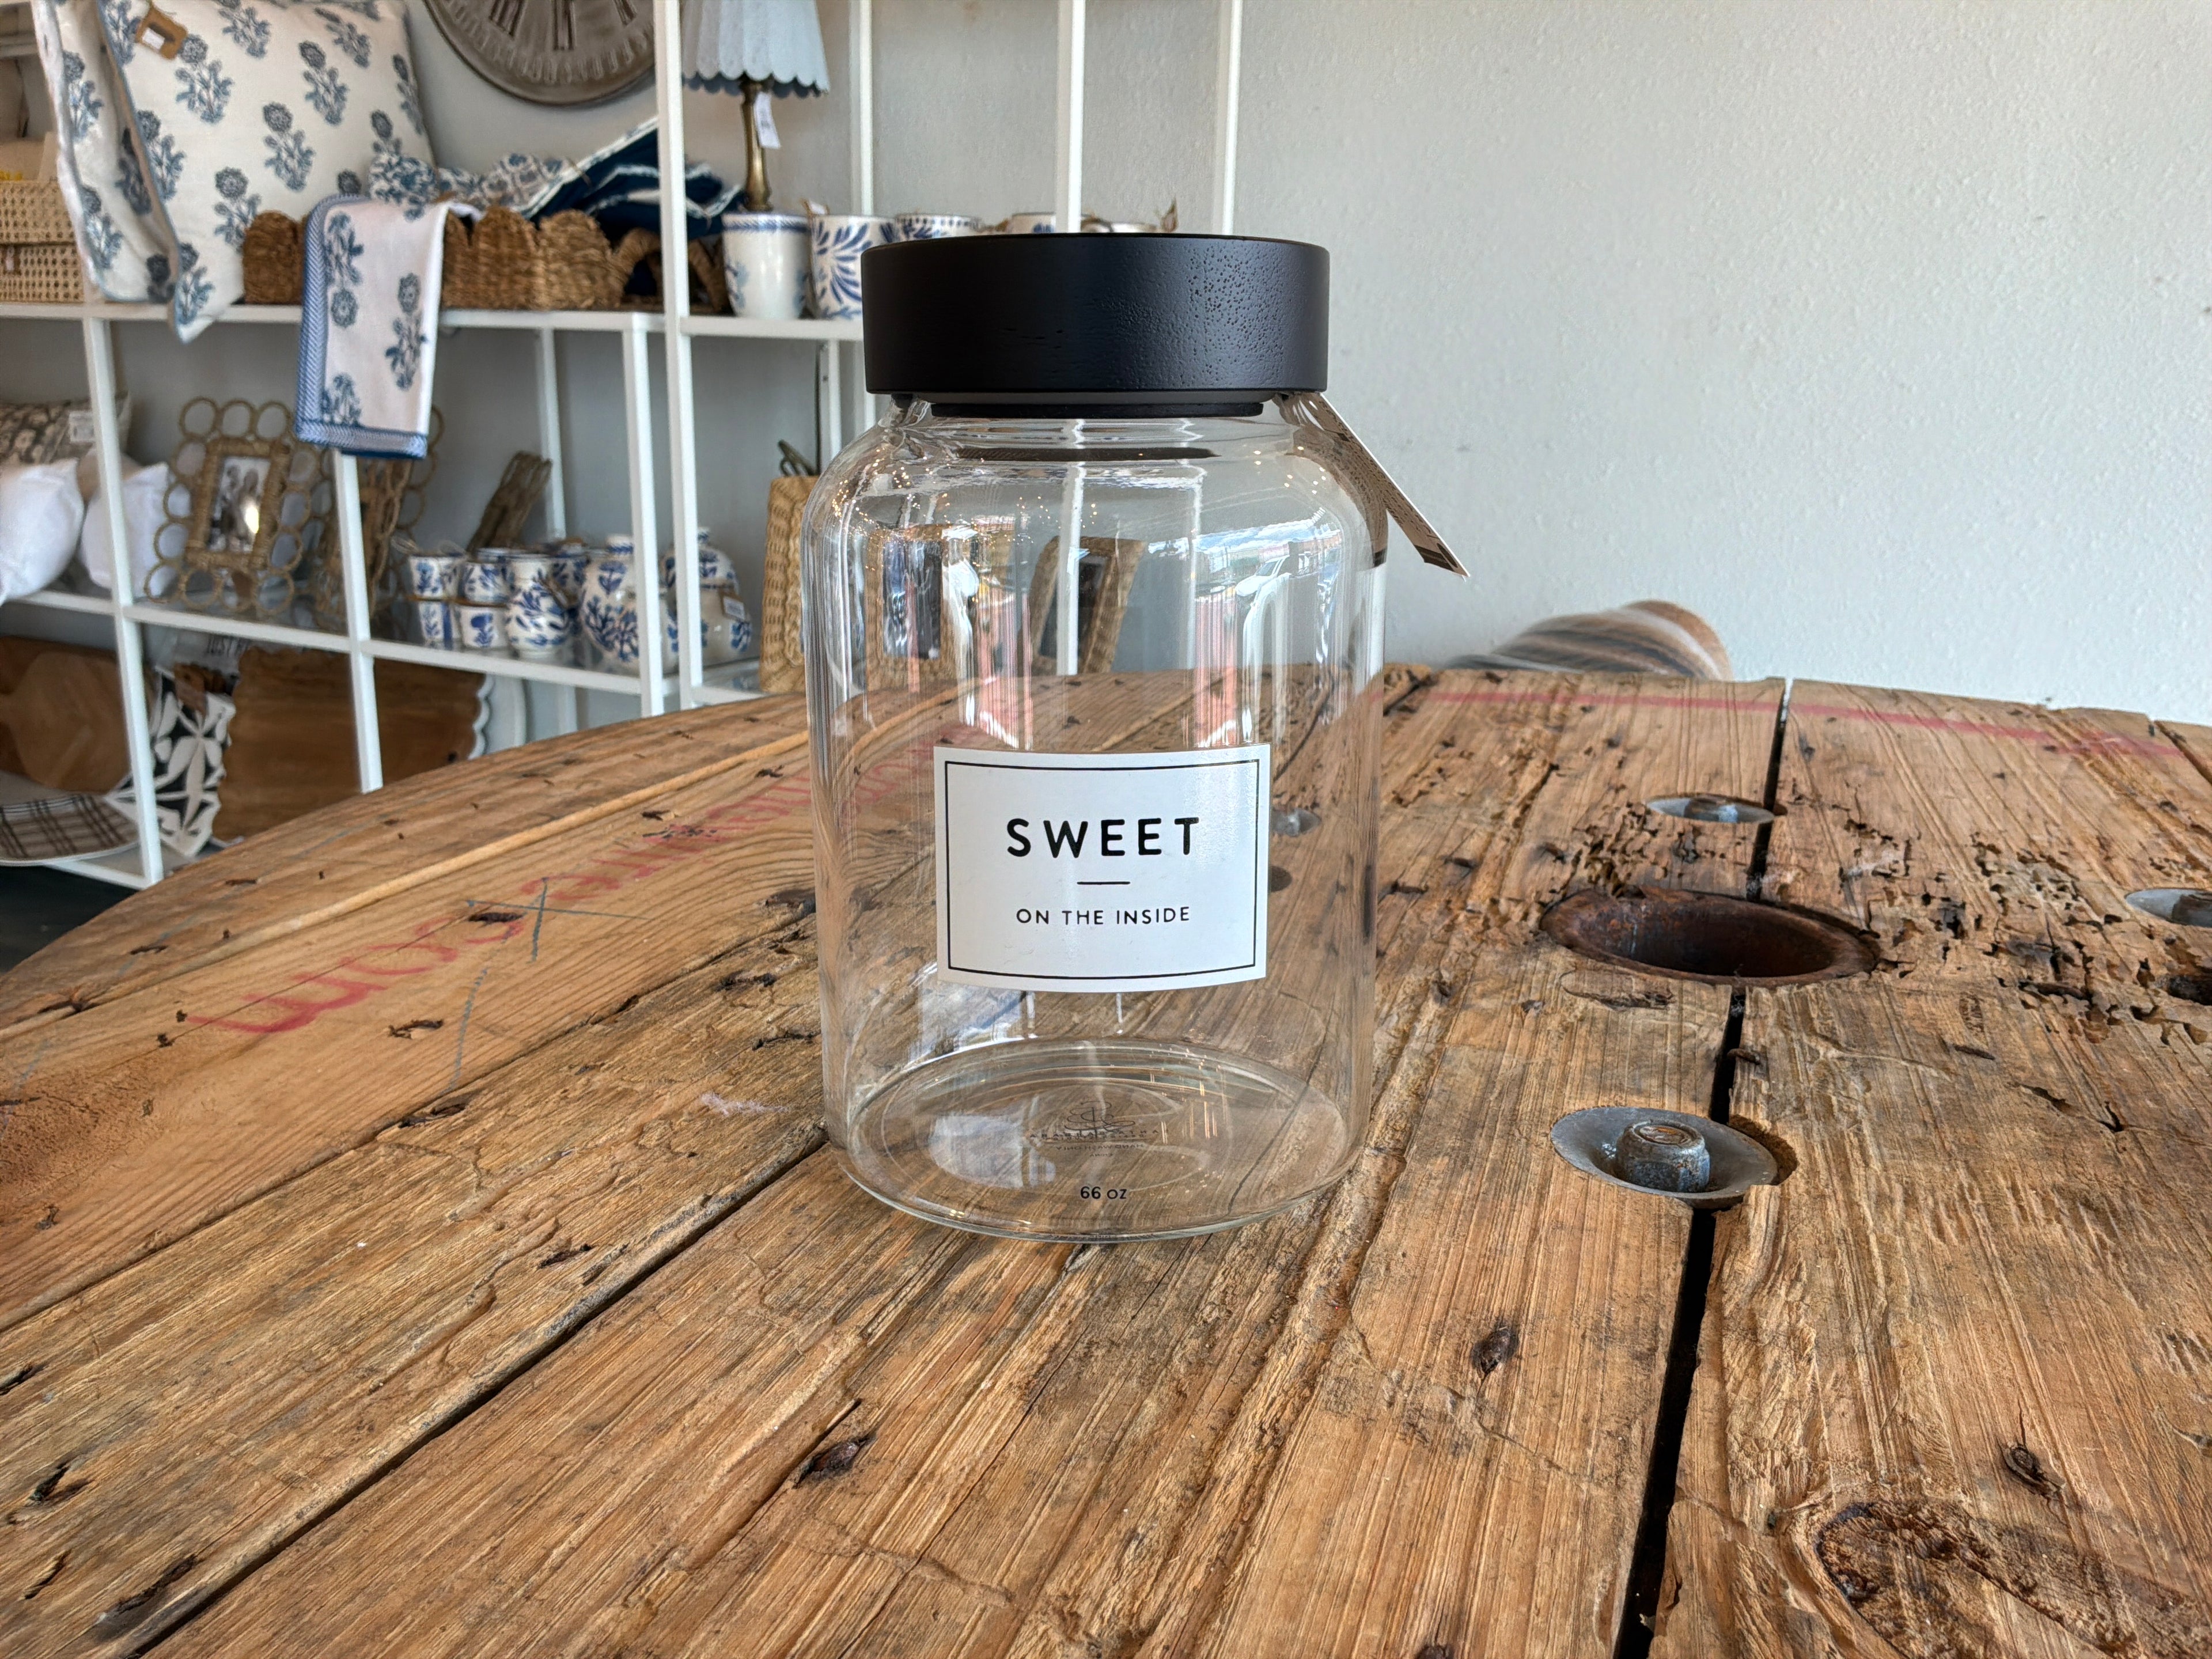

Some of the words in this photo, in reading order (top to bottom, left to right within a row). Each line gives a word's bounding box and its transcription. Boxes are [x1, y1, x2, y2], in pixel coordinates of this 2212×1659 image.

[1007, 817, 1199, 858] SWEET
[1016, 909, 1049, 924] ON
[1062, 910, 1104, 925] THE
[1117, 906, 1190, 924] INSIDE
[1081, 1186, 1101, 1199] 66
